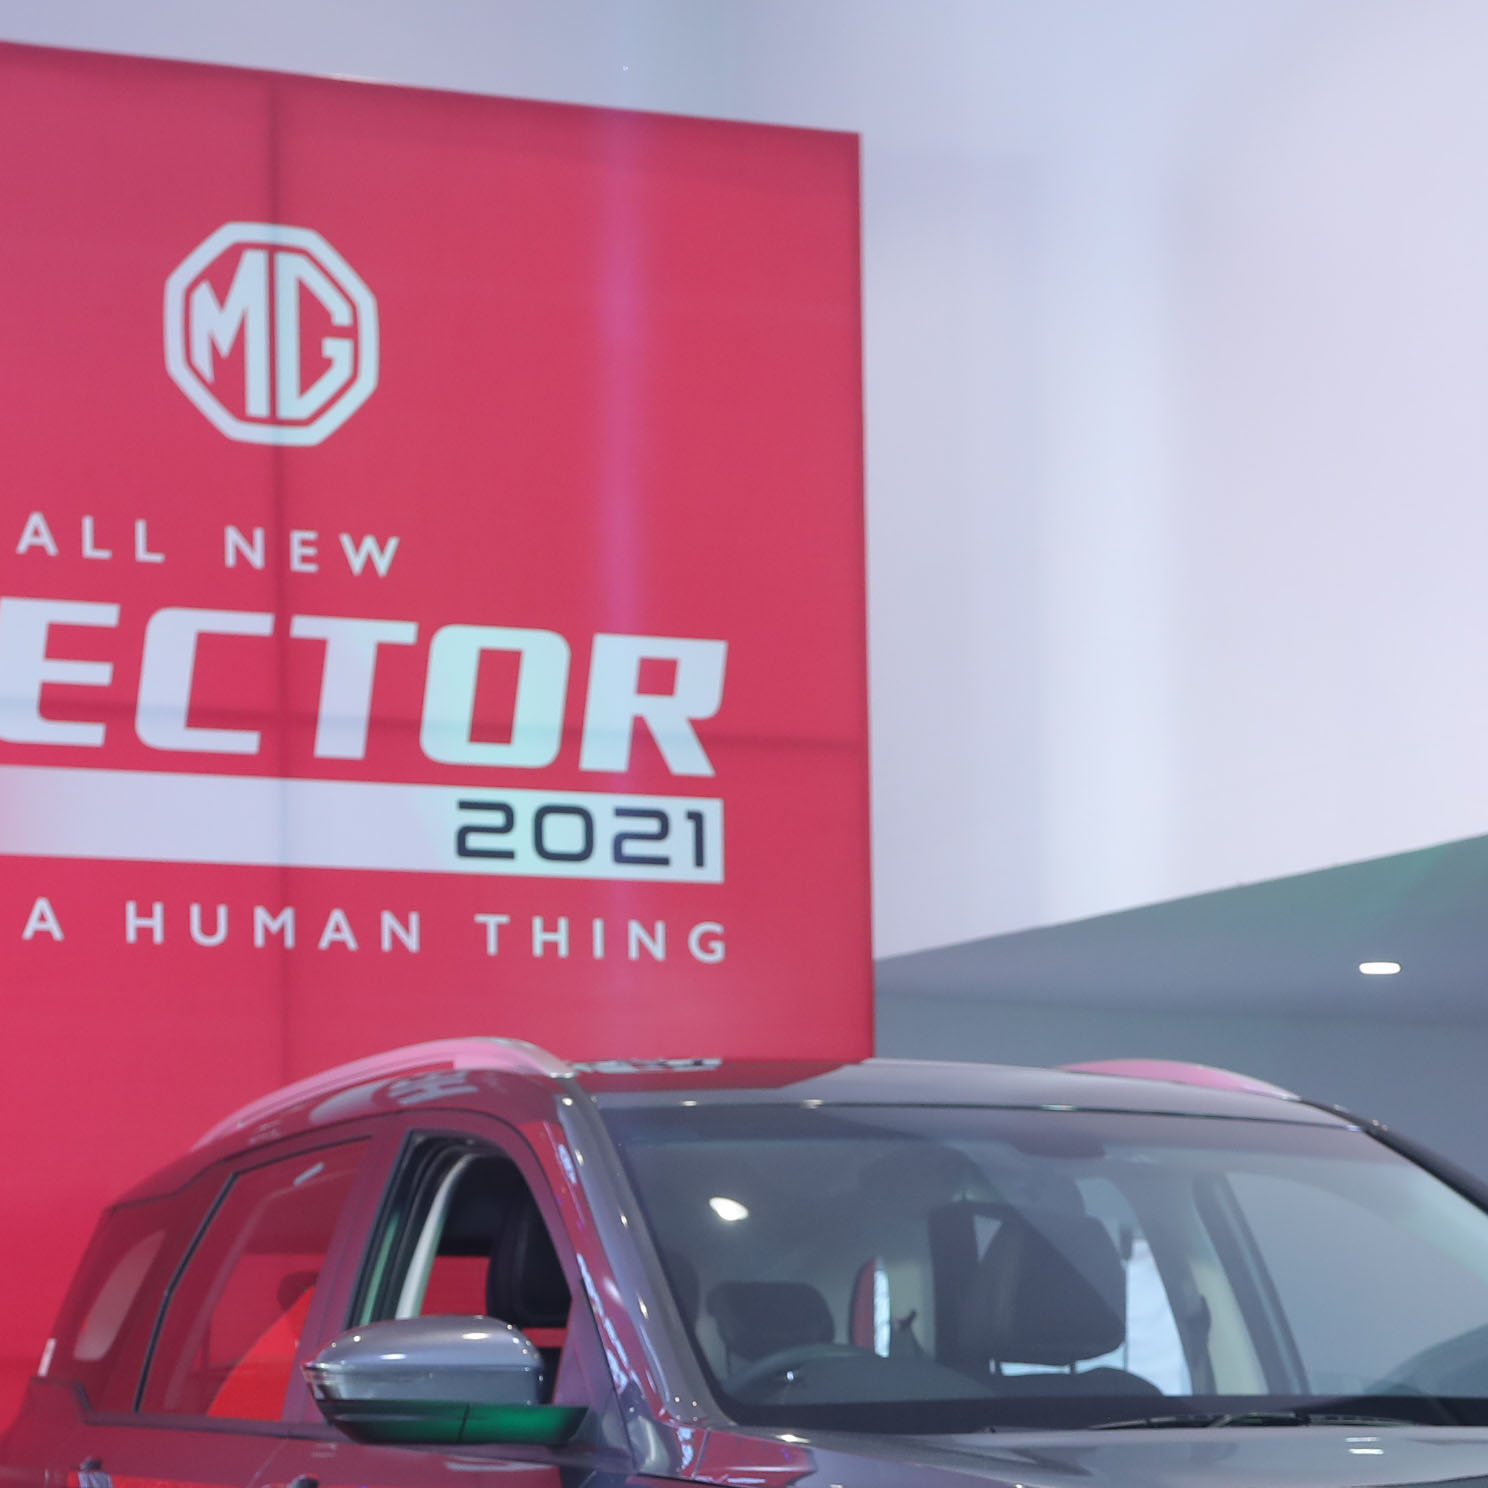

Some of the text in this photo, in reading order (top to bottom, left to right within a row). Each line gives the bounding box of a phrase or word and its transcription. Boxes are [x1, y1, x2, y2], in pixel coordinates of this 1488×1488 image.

[187, 248, 356, 420] MG
[16, 511, 167, 564] ALL
[224, 525, 401, 578] NEW
[455, 800, 706, 869] 2021
[22, 897, 65, 942] A
[125, 900, 421, 953] HUMAN
[474, 913, 726, 964] THING
